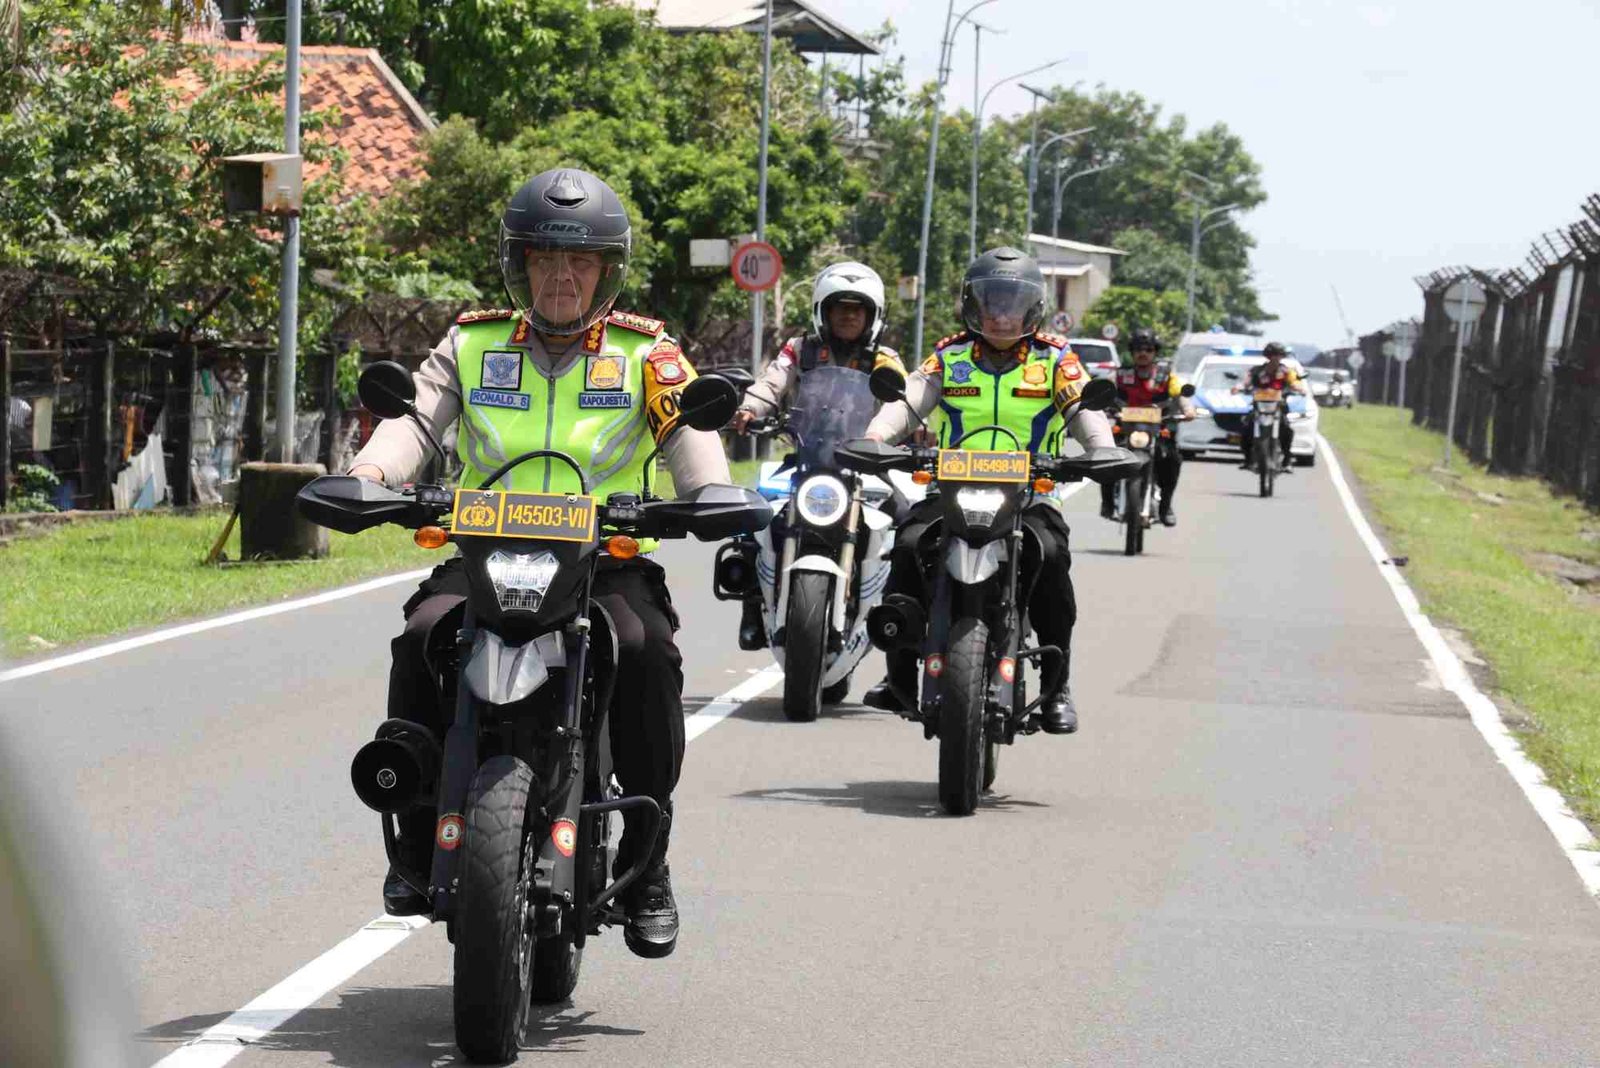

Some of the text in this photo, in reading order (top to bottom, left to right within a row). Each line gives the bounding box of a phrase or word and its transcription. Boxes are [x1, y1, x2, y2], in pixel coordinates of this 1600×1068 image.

[740, 255, 759, 280] 40
[946, 387, 977, 396] JOKO
[973, 458, 1025, 473] 145498-VII
[507, 504, 588, 529] 145503-VII
